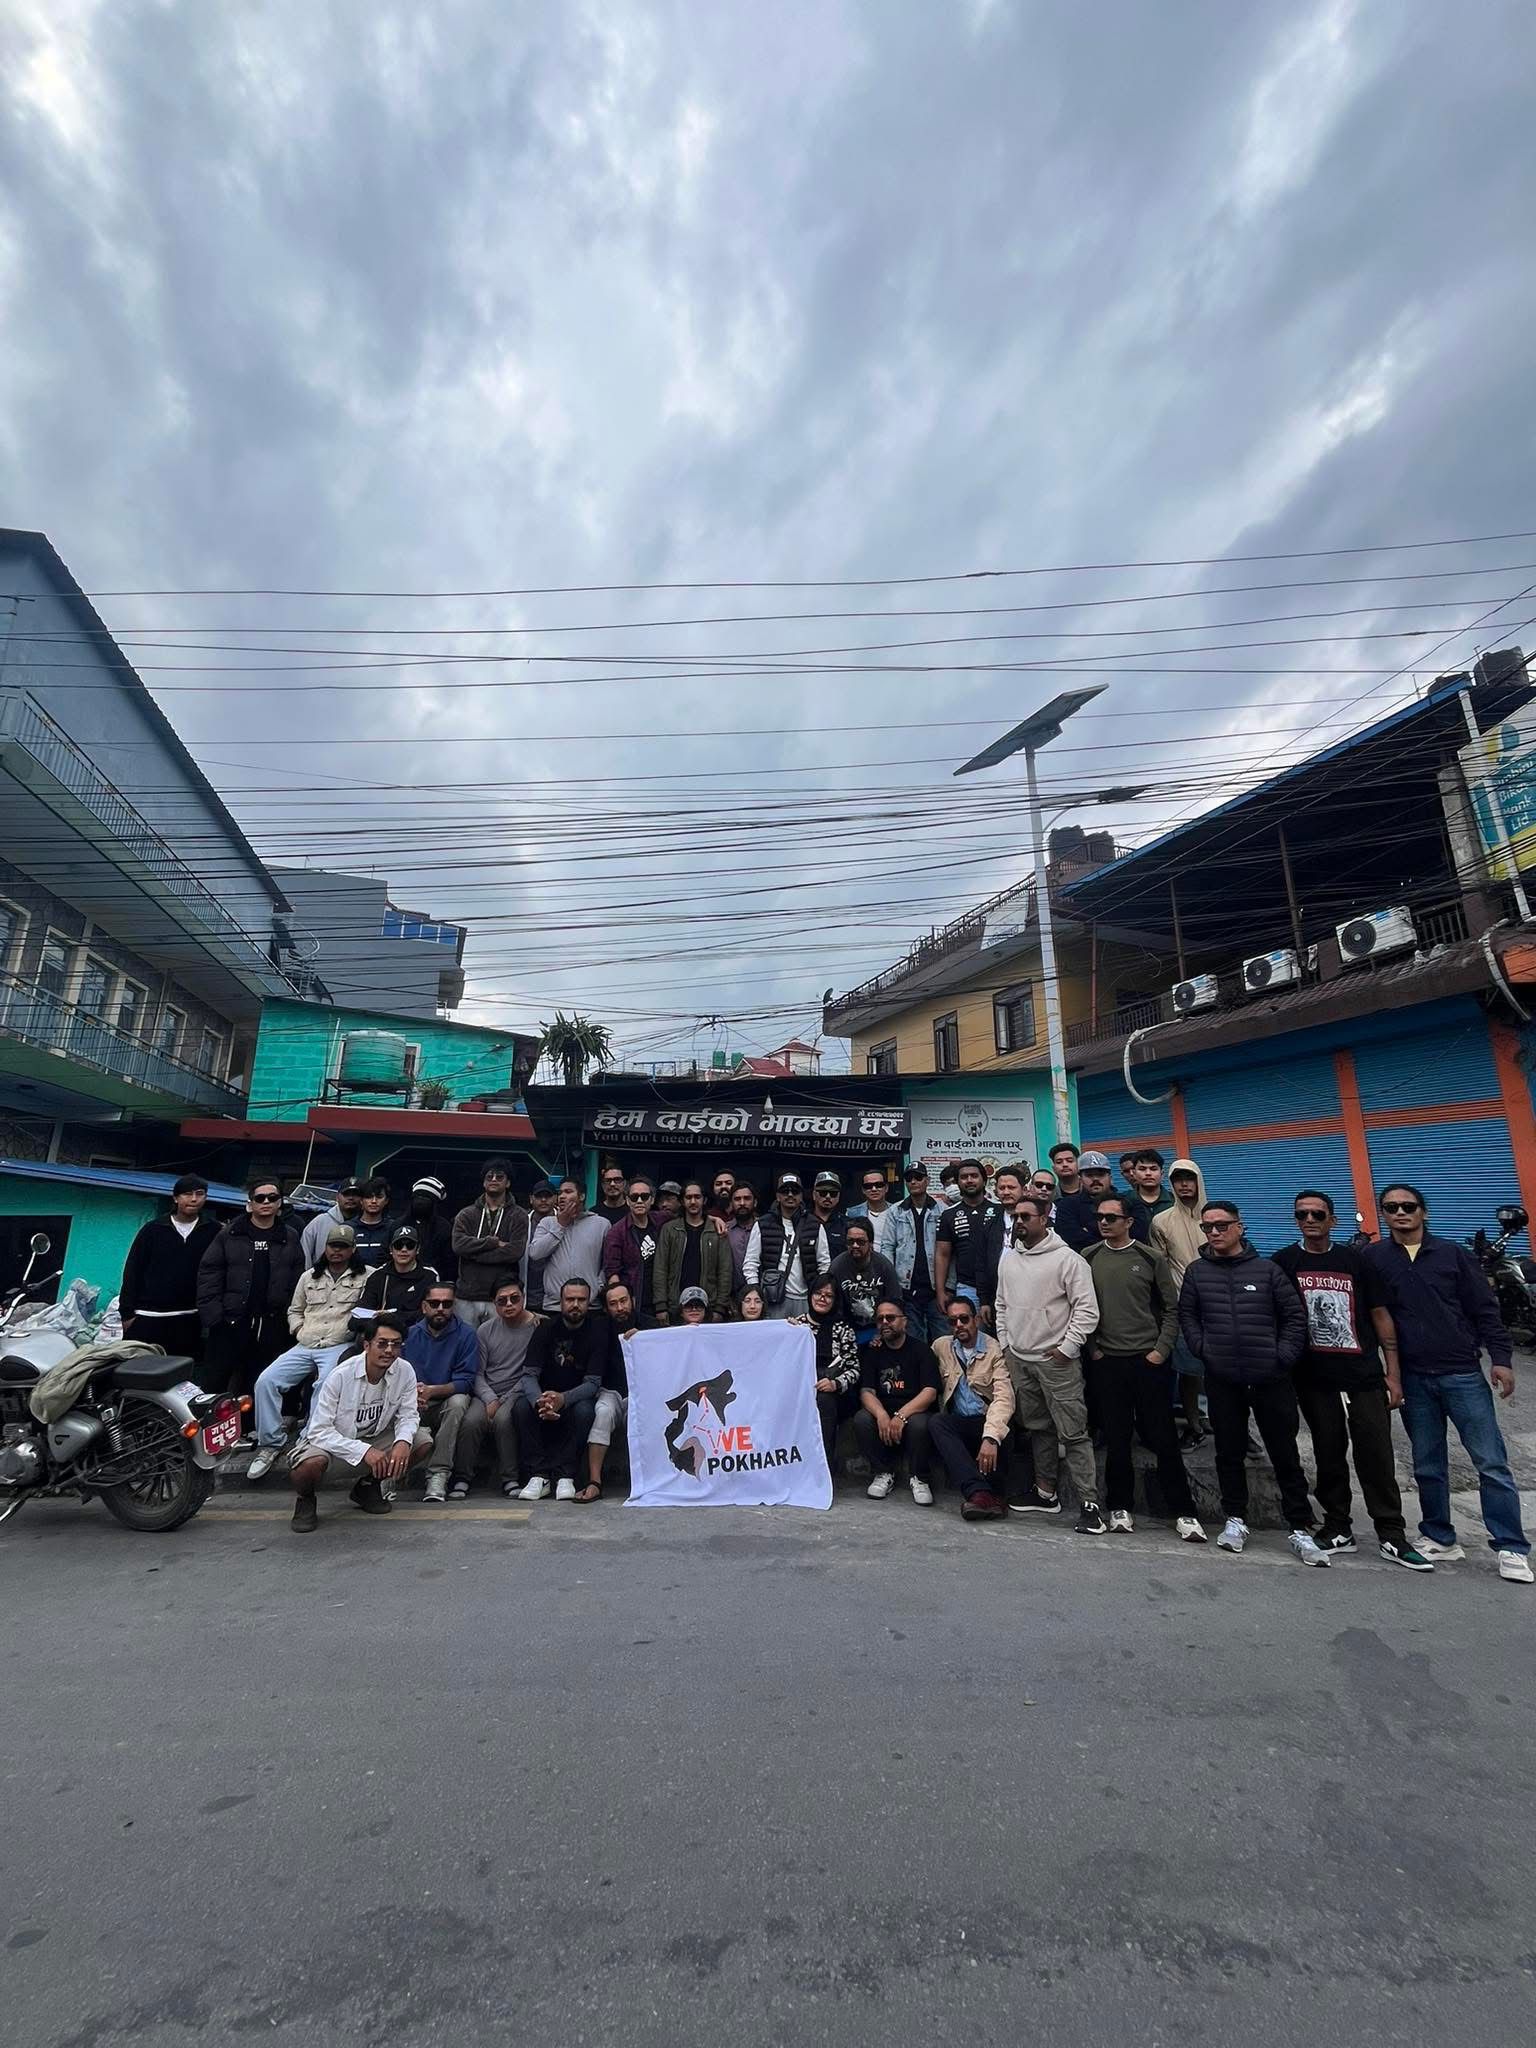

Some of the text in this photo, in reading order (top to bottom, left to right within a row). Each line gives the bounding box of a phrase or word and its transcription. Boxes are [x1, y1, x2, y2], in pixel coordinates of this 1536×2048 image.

[593, 1104, 904, 1137] हेम दाईको भान्छा घर
[592, 1131, 903, 1152] You don't need to be rich to have a healthy food
[926, 1138, 941, 1149] हेम
[944, 1138, 975, 1149] दाईको
[708, 1446, 802, 1474] POKHARA
